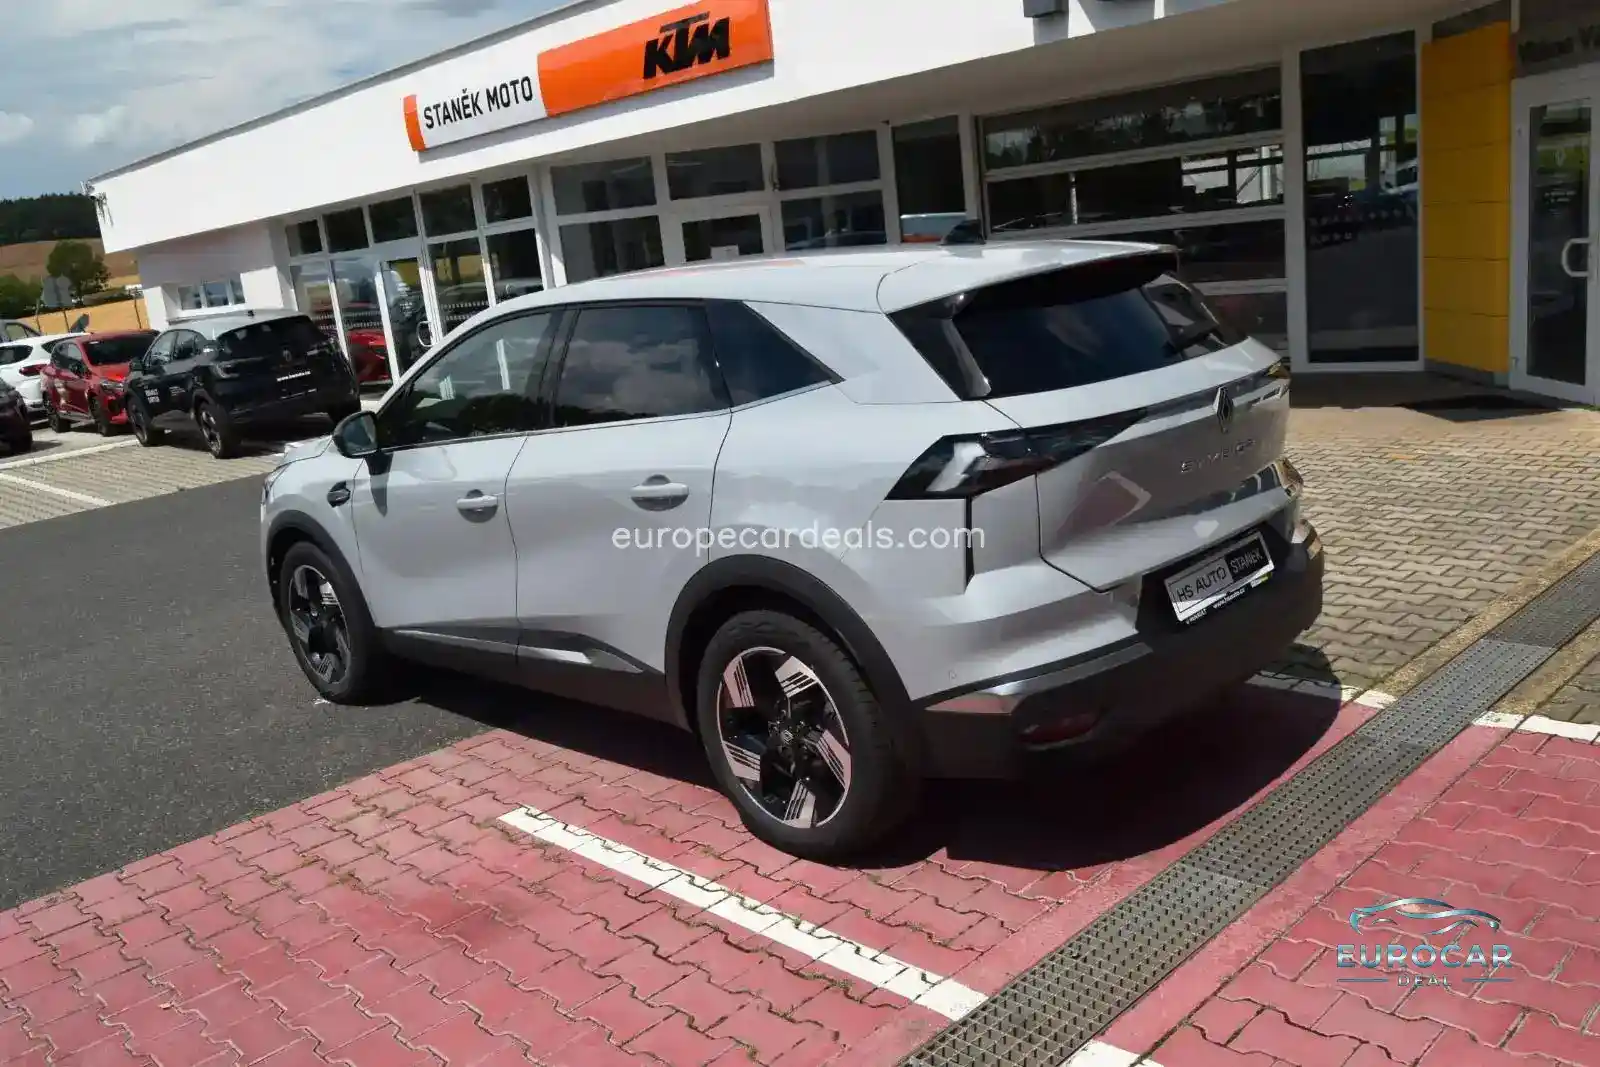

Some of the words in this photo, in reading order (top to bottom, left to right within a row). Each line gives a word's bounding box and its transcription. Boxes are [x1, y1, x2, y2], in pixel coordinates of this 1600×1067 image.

[643, 12, 732, 80] KTM
[423, 87, 483, 129] STANĚK
[486, 76, 533, 112] MOTO
[1176, 584, 1194, 602] HS
[1196, 567, 1226, 593] AUTO
